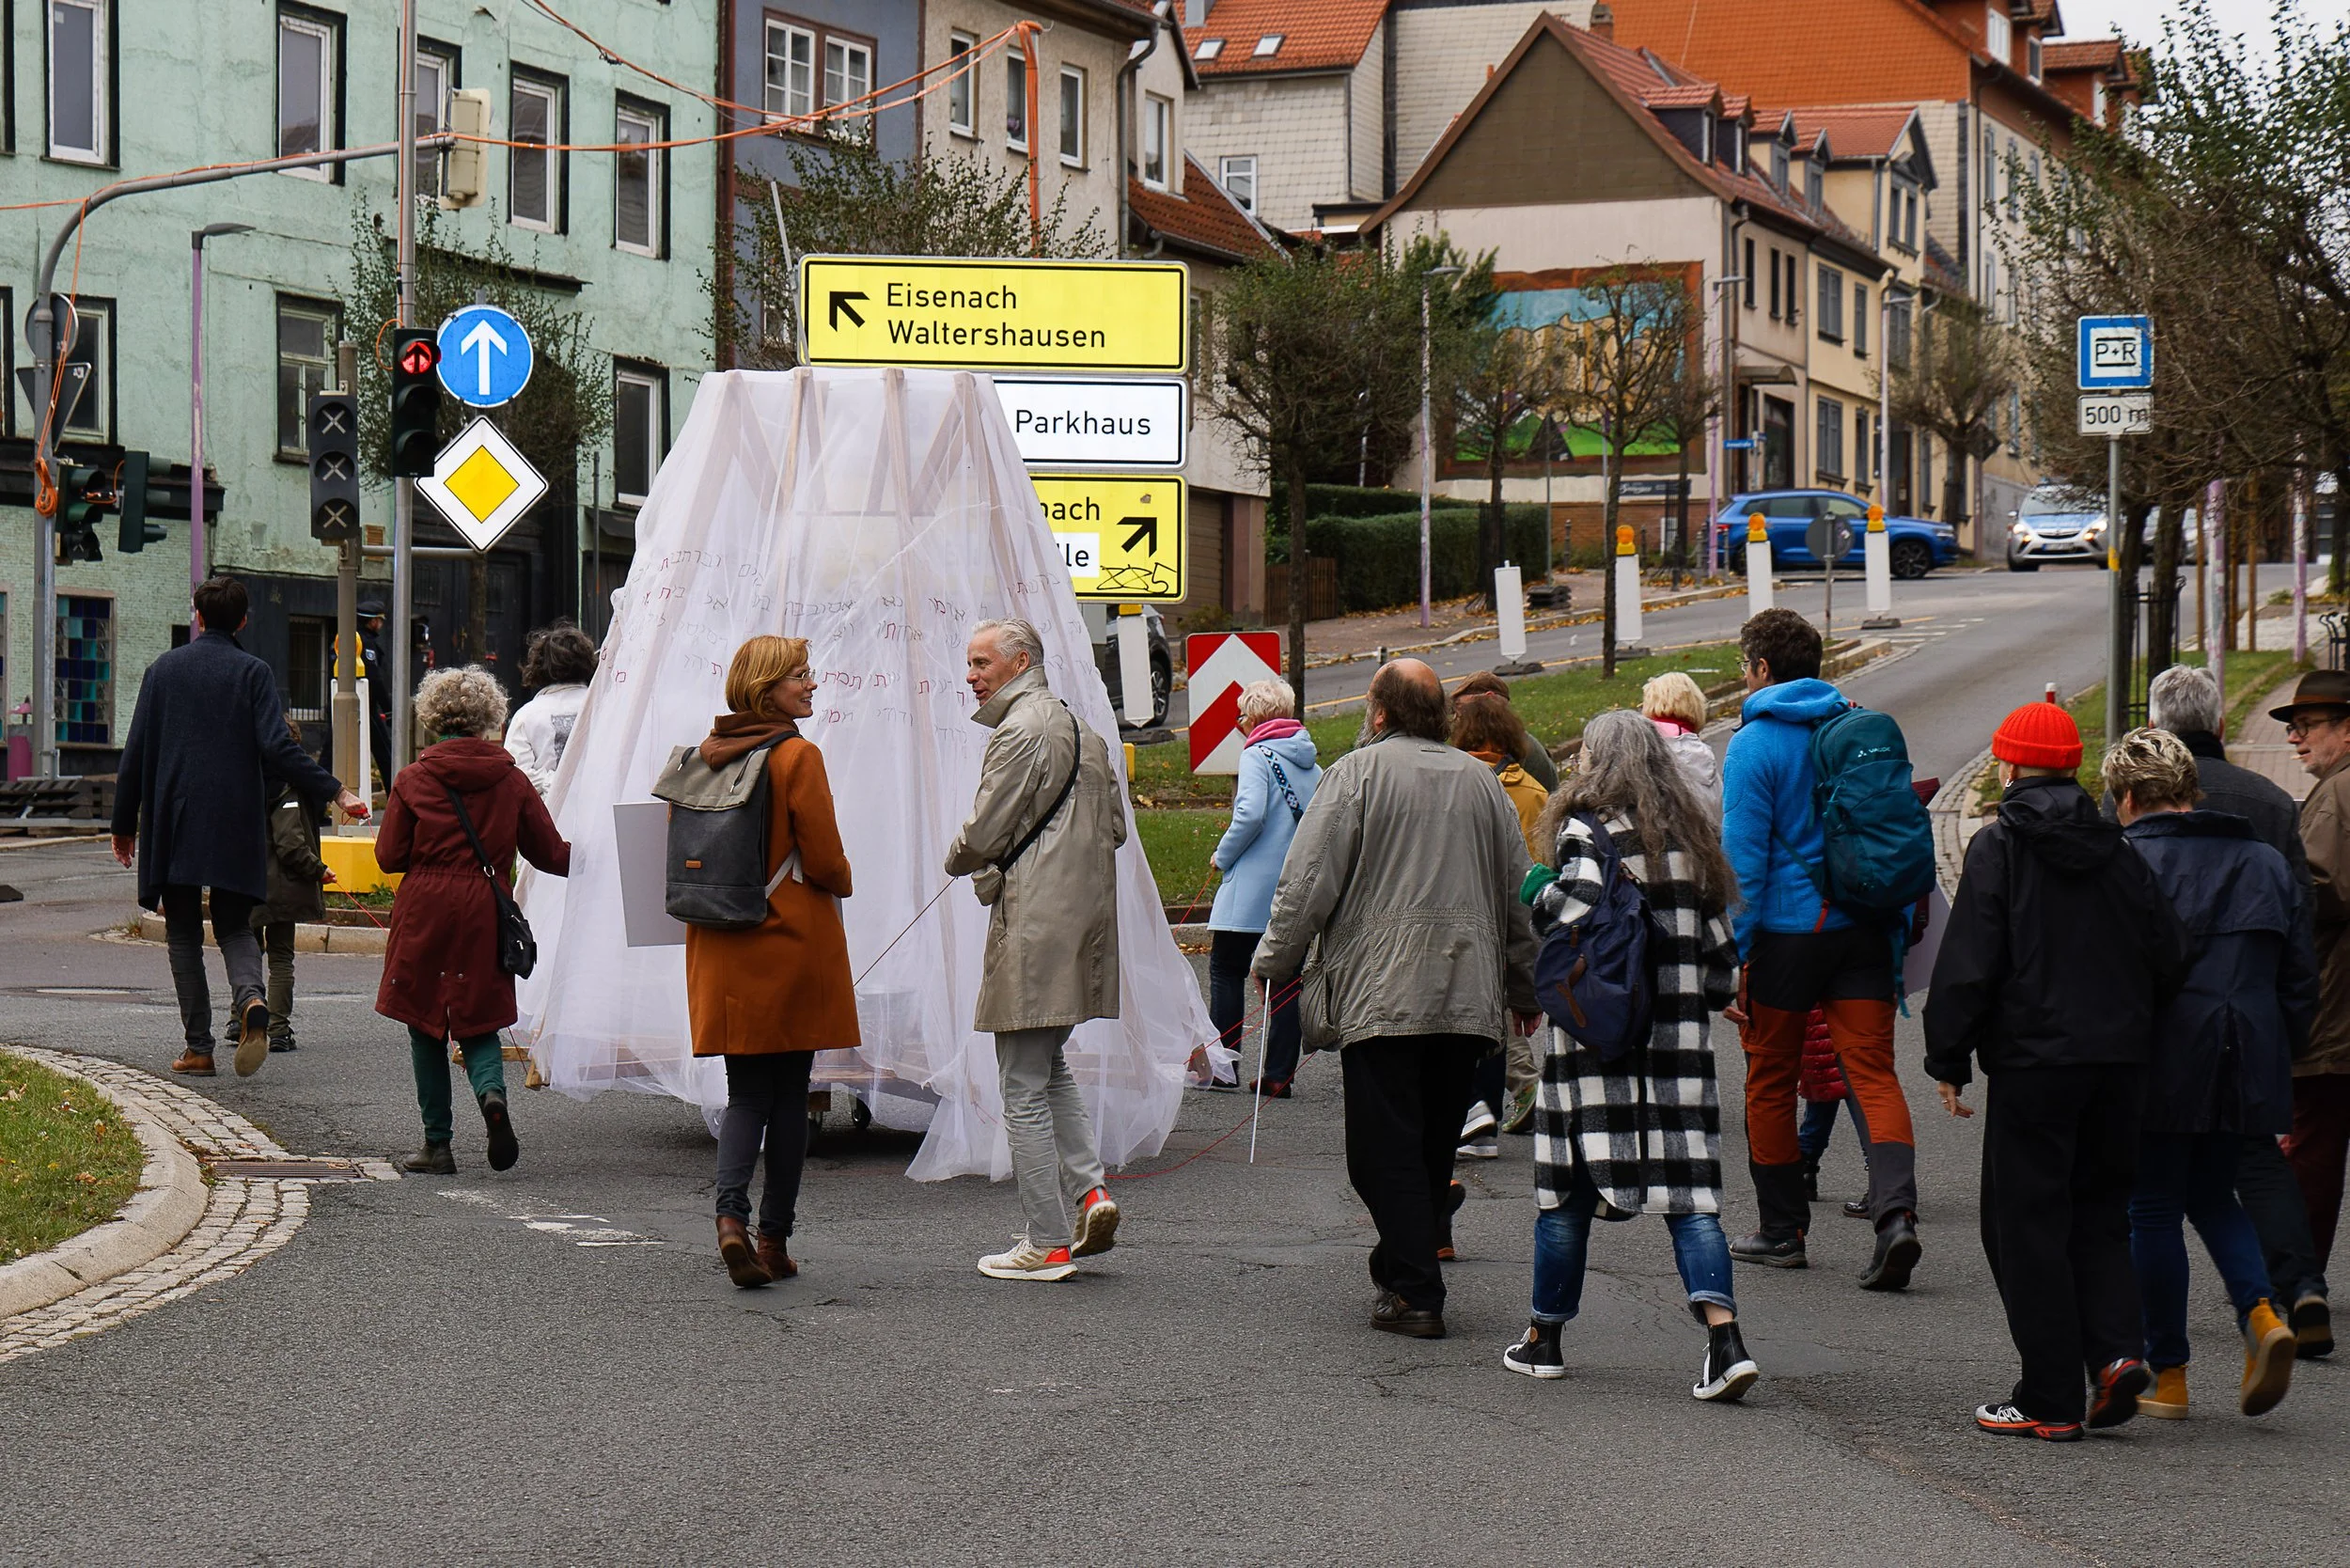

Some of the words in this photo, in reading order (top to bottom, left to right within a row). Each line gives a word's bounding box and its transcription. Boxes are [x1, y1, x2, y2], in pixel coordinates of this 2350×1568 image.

[886, 282, 1017, 309] Eisenach
[887, 319, 1105, 348] Waltershausen
[2095, 342, 2137, 362] P+R
[1016, 409, 1151, 435] Parkhaus
[2085, 405, 2122, 424] 500
[1057, 542, 1090, 567] le
